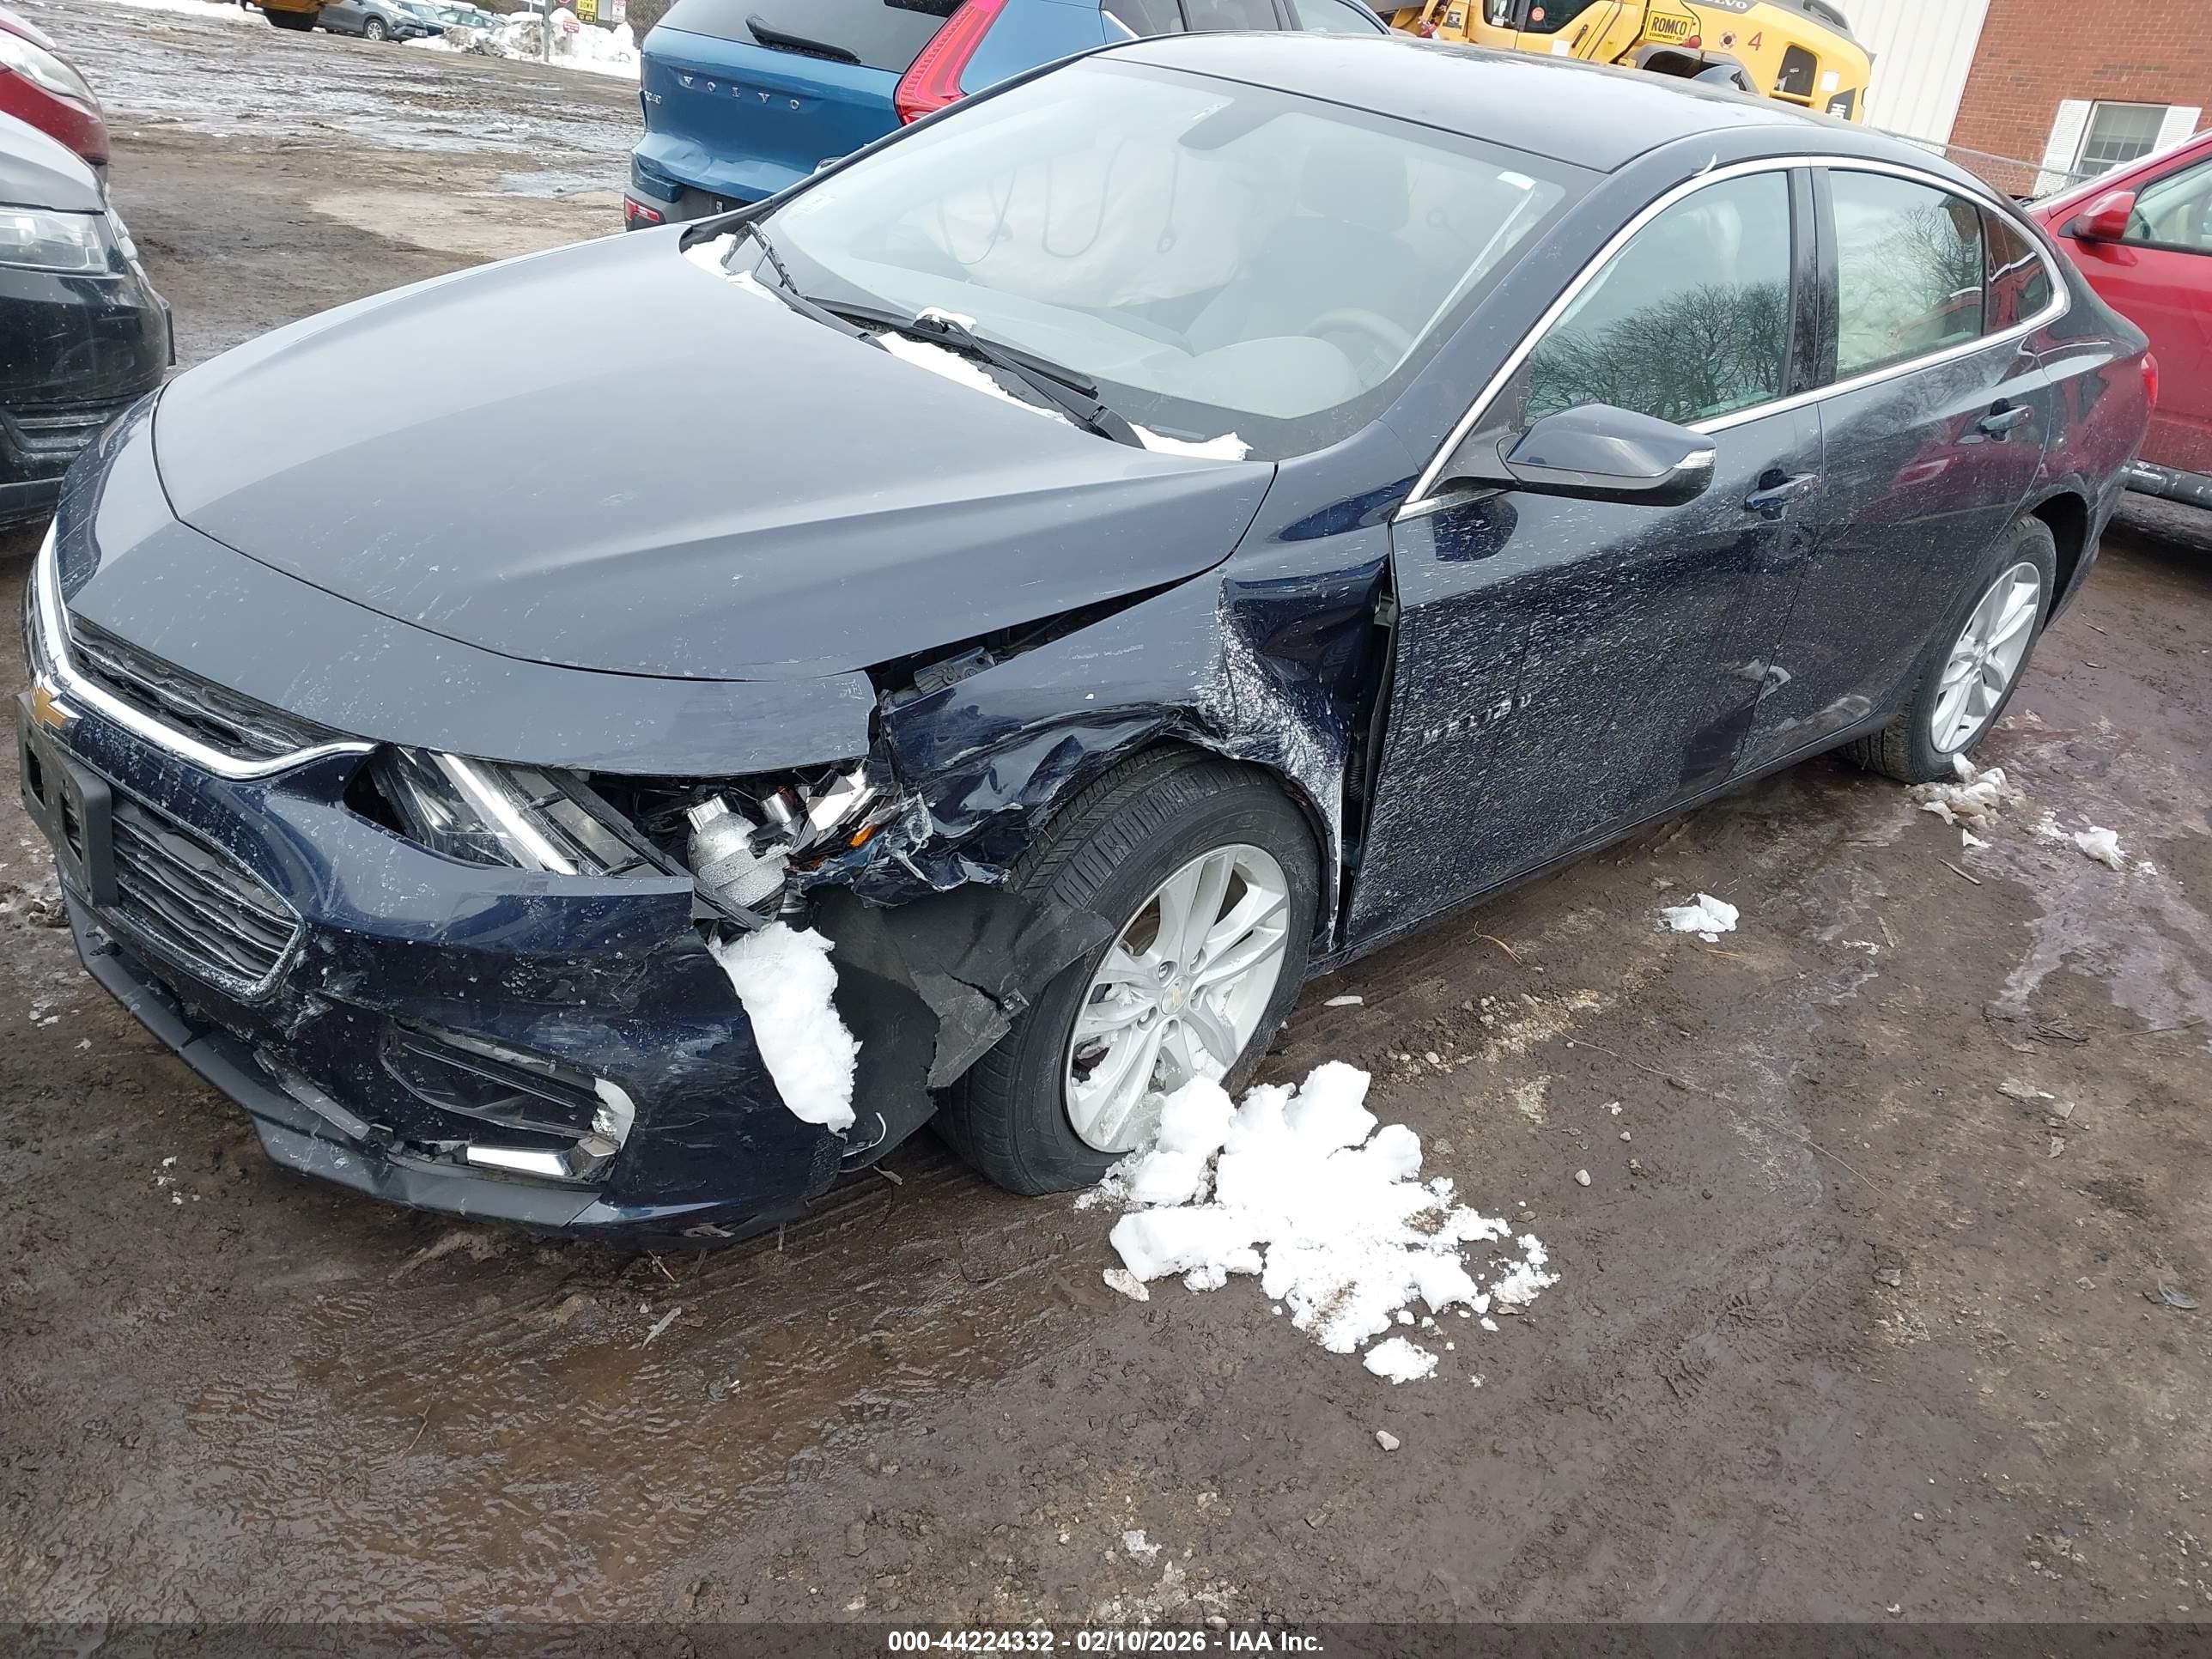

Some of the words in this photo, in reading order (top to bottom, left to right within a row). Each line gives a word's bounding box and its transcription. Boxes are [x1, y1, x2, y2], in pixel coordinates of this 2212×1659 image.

[1705, 0, 1747, 9] LVO
[1650, 16, 1688, 36] ROMCO
[1747, 31, 1762, 52] 4
[684, 76, 800, 110] VOLVO
